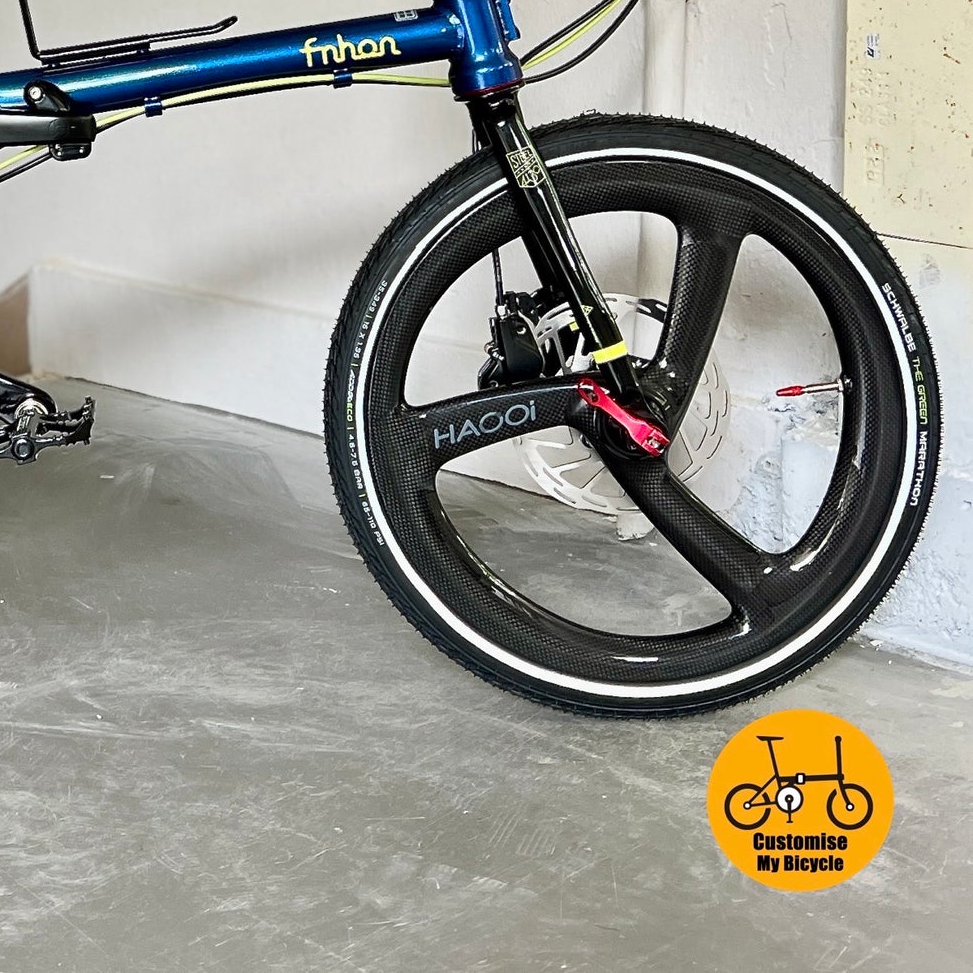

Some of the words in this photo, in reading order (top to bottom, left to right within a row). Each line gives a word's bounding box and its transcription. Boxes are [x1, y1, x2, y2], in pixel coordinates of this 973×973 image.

[299, 33, 402, 68] fnhon
[881, 282, 917, 353] SCHWALBE
[912, 356, 924, 382] THE
[917, 384, 928, 425] GREEN
[909, 431, 928, 506] MARATHON
